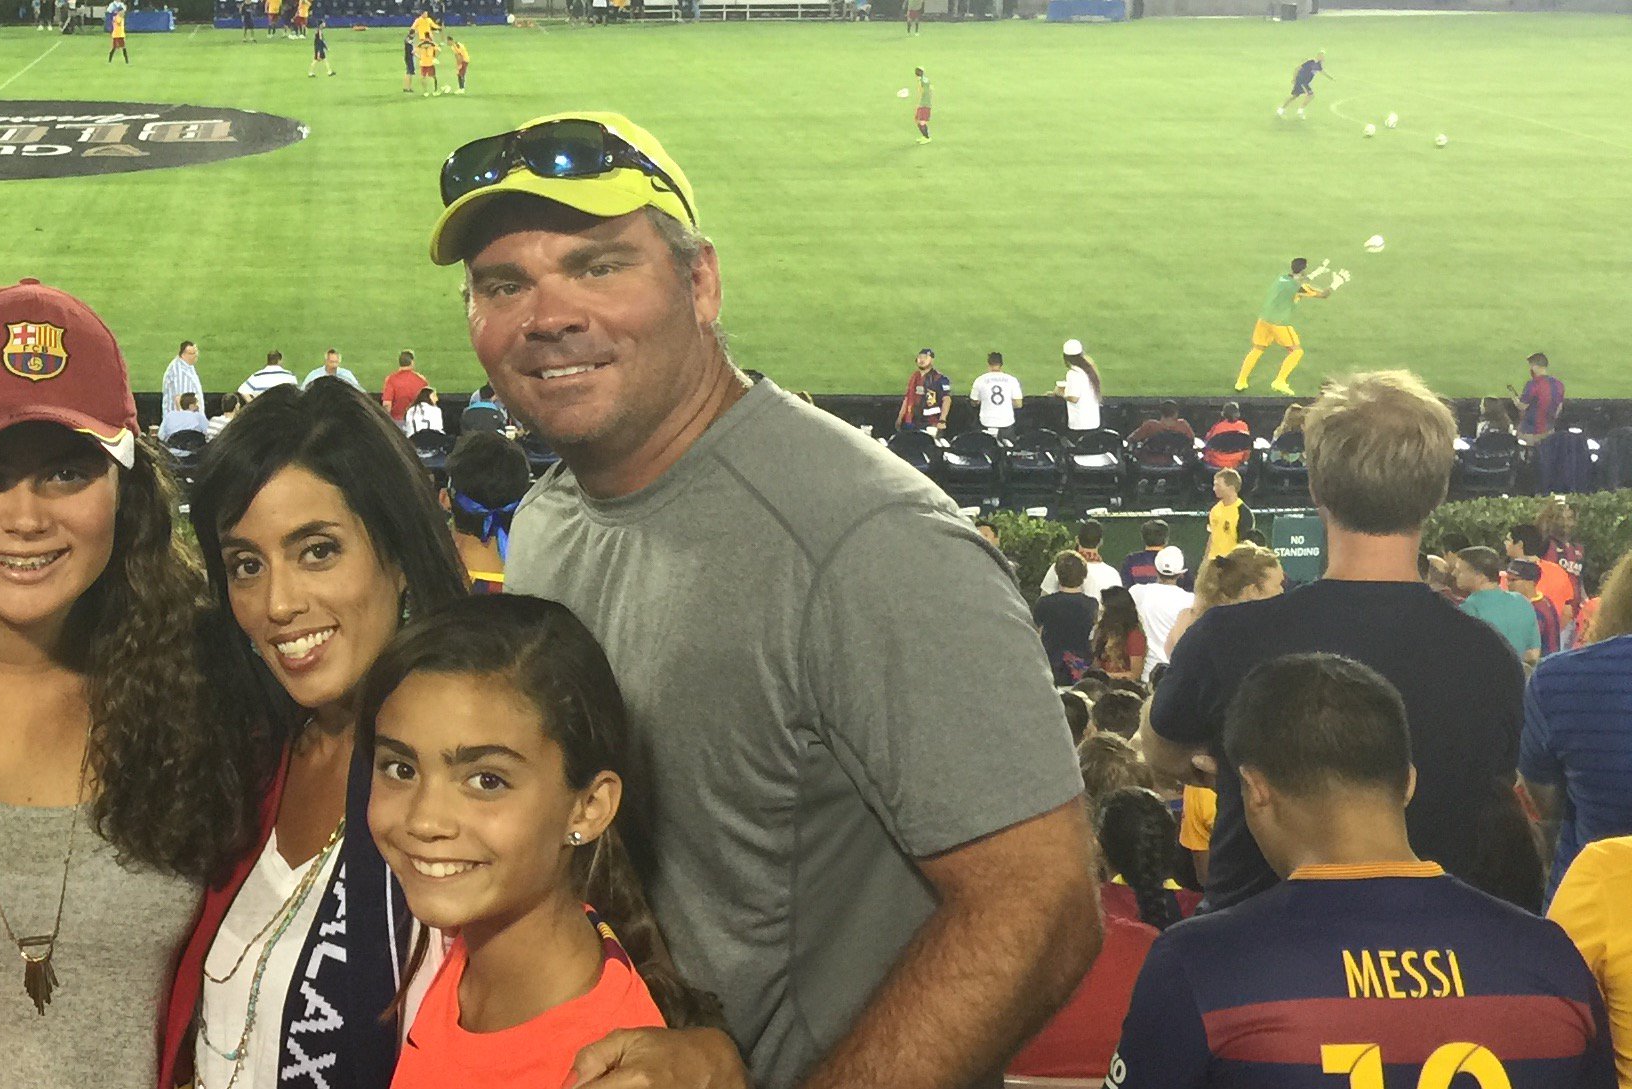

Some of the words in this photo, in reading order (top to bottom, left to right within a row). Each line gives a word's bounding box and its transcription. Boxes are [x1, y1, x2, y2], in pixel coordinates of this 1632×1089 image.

[990, 384, 1005, 406] 8
[1290, 535, 1305, 545] NO
[1273, 546, 1320, 557] STANDING
[1341, 948, 1466, 999] MESSI
